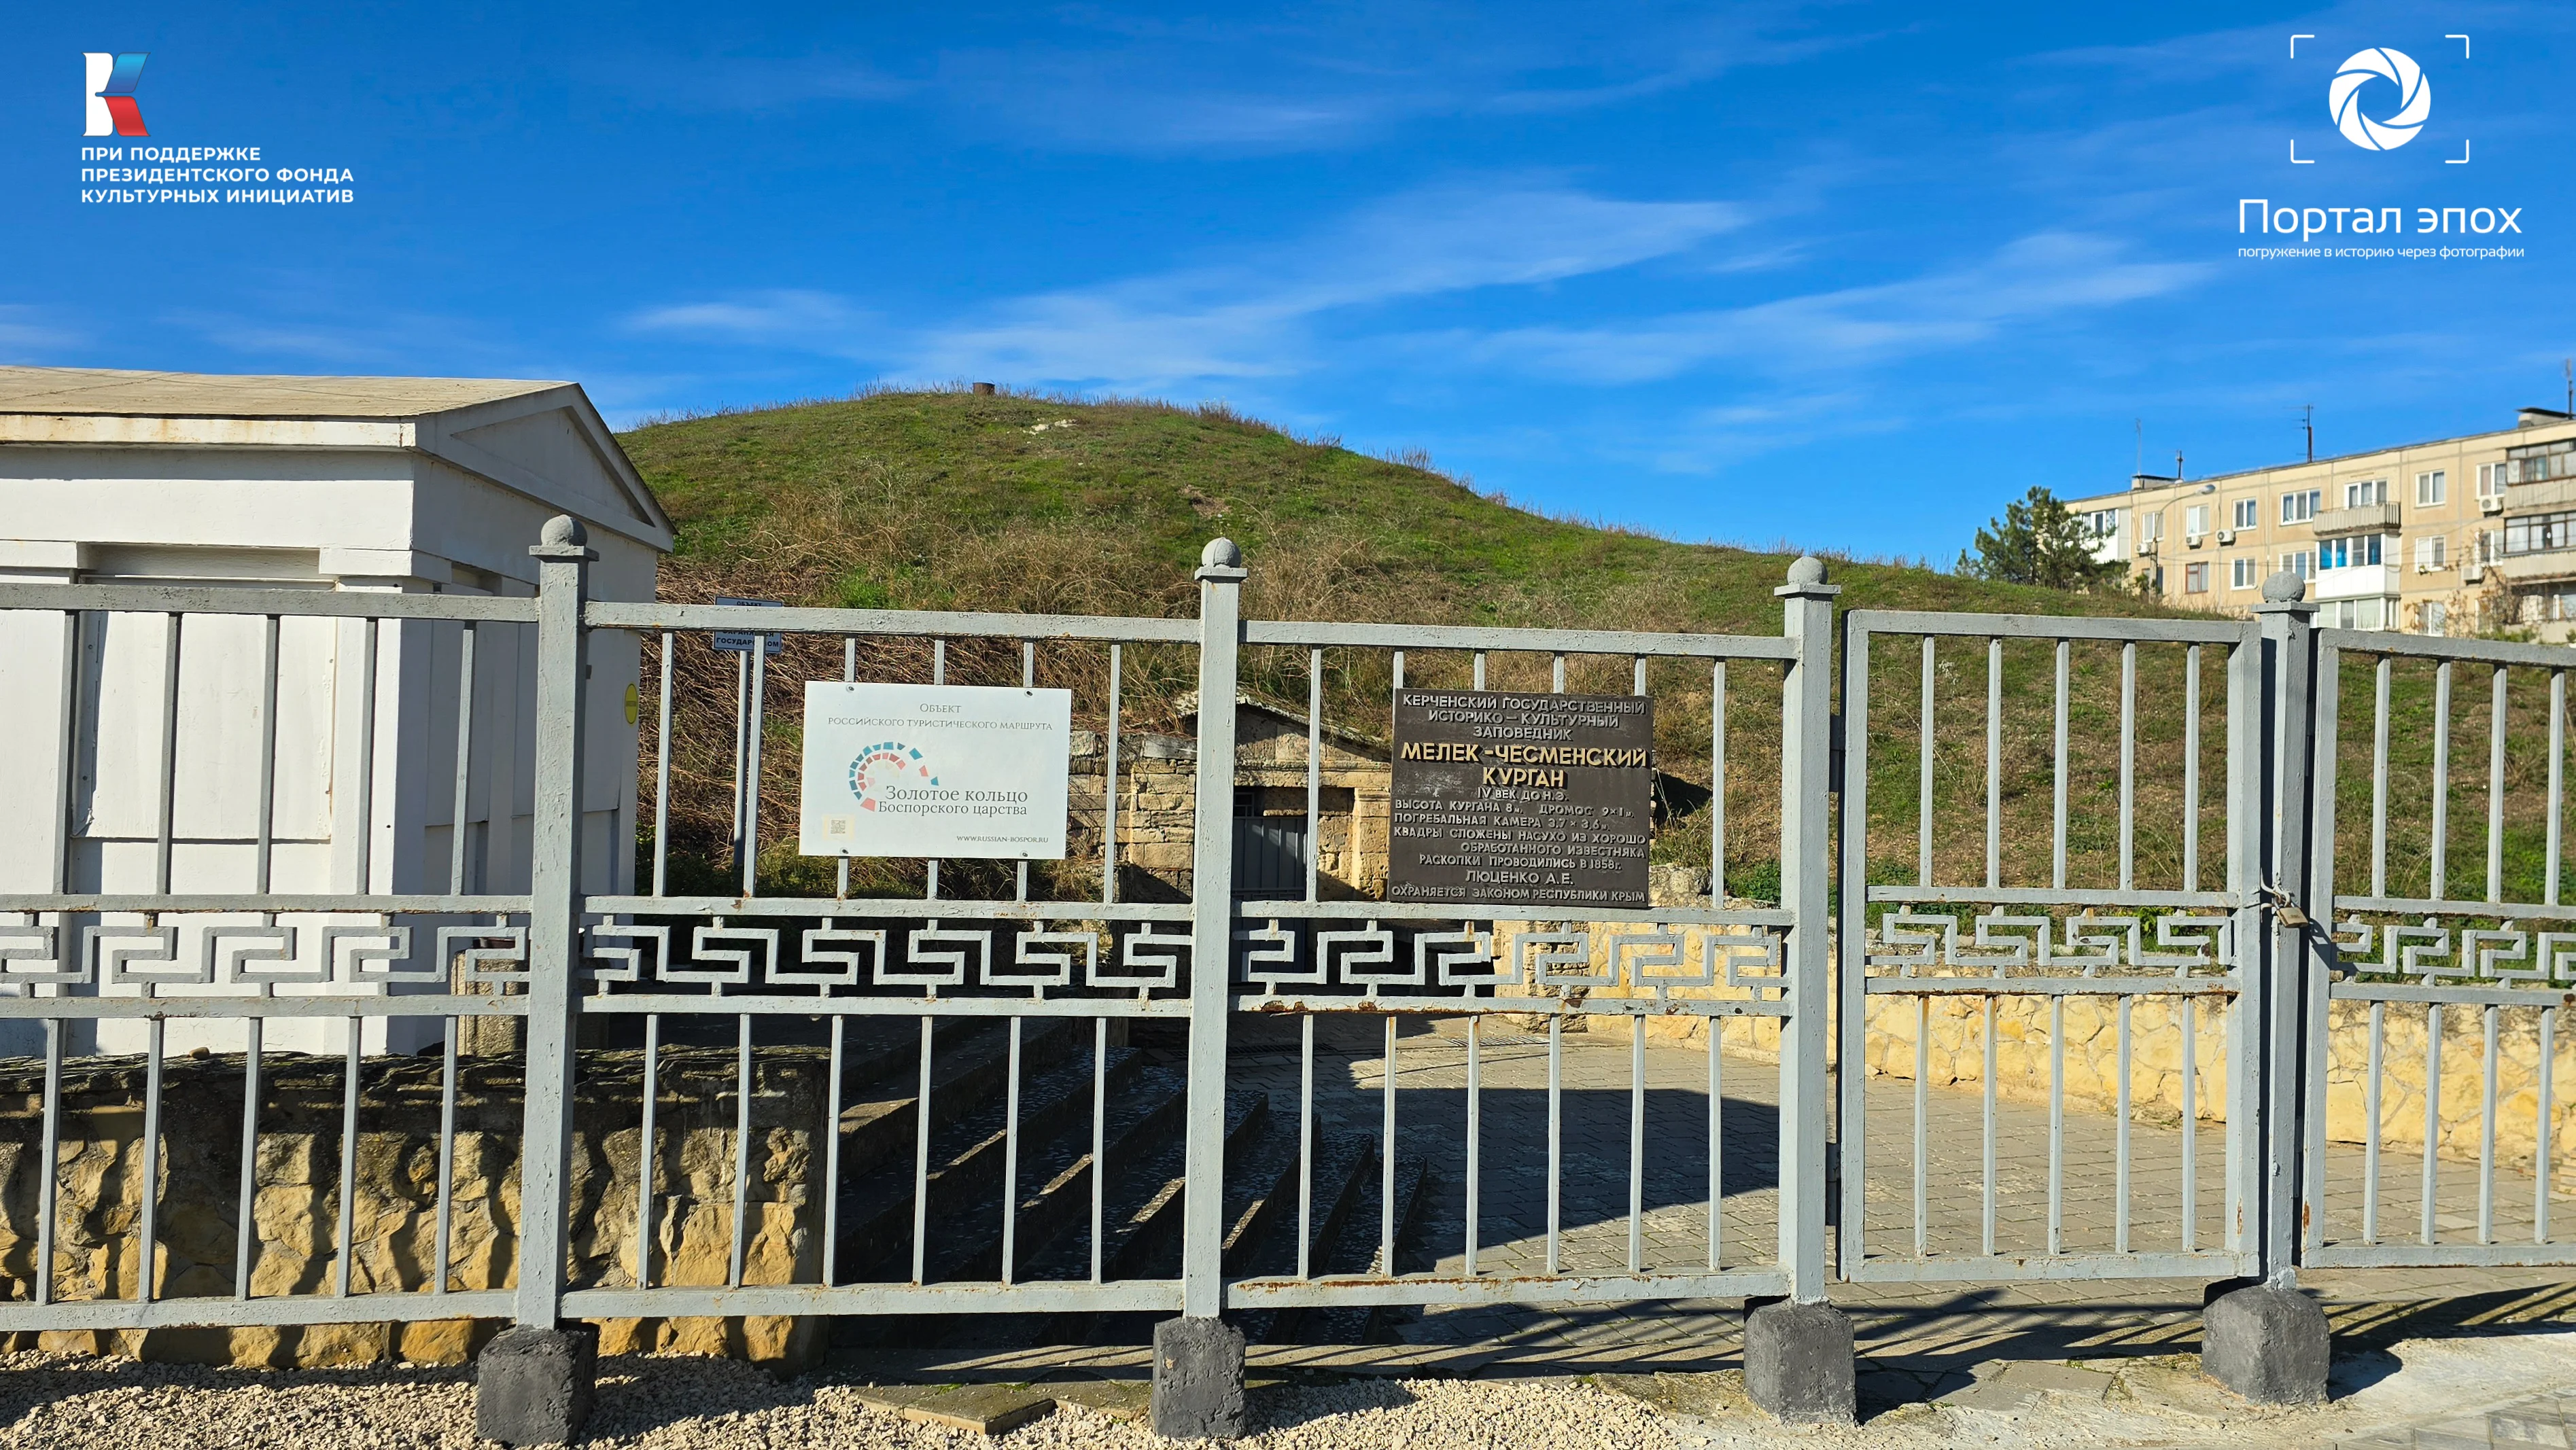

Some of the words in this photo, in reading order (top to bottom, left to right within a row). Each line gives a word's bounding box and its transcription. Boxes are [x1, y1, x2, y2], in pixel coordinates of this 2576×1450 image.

[1403, 694, 1497, 709] КЕРЧЕНСКИЙ
[1502, 696, 1646, 713] ГОСУДАРСТВЕННЫЙ
[828, 717, 905, 726] РОССИЙСКОГО
[907, 719, 998, 729] ТУРИСТИЧЕСКОГО
[1000, 721, 1053, 730] МАРШРУТА
[1429, 709, 1504, 724] ИСТОРИКО
[1521, 713, 1620, 728] КУЛЬТУРНЫЙ
[1473, 726, 1573, 741] ЗАПОВЕДНИК
[1483, 767, 1564, 788] КУРГАН
[886, 785, 959, 800] Золотое
[964, 790, 1028, 804] кольцо
[1478, 787, 1491, 799] IV
[1495, 790, 1516, 799] ВЕК
[878, 801, 969, 815] Боспорского
[973, 804, 1027, 817] царства
[1395, 799, 1443, 810] ВЫСОТА
[1449, 800, 1501, 812] КУРГАНА
[1539, 804, 1594, 816] ДРОМОС
[1394, 813, 1487, 826] ПОГРЕБАЛЬНАЯ
[1494, 815, 1542, 828] КАМЕРА
[1394, 826, 1443, 838] КВАДРЫ
[1450, 829, 1512, 840] СЛОЖЕНЫ
[1518, 831, 1566, 841] НАСУХО
[1571, 832, 1586, 843] ИЗ
[1592, 834, 1646, 844] ХОРОШО
[1461, 842, 1562, 855] ОБРАБОТАННОГО
[1567, 845, 1646, 858] ИЗВЕСТНЯКА
[1419, 853, 1481, 866] РАСКОПКИ
[1489, 855, 1576, 868] ПРОВОДИЛИСЬ
[1465, 870, 1539, 883] ЛЮЦЕНКО
[1391, 885, 1466, 897] ОХРАНЯЕТСЯ
[1472, 888, 1530, 899] ЗАКОНОМ
[1533, 889, 1607, 901] РЕСПУБЛИКИ
[1612, 891, 1646, 902] КРЫМ
